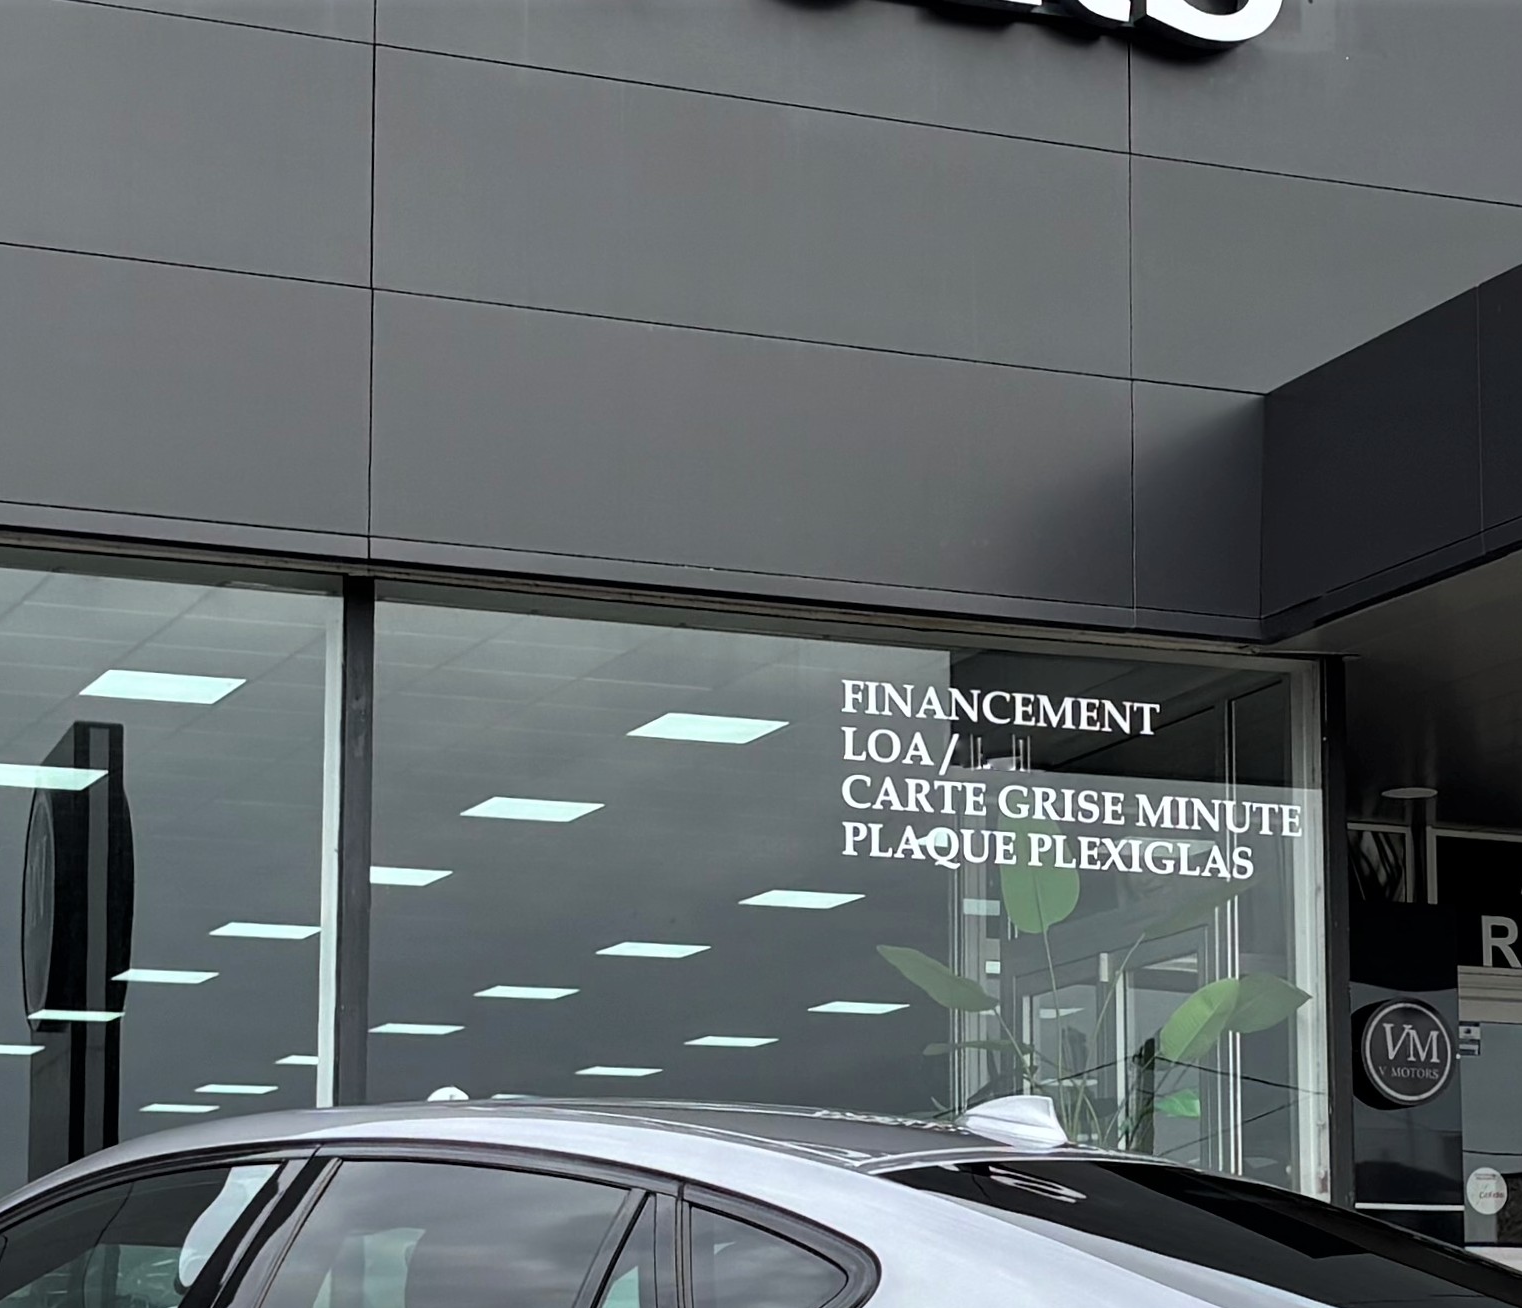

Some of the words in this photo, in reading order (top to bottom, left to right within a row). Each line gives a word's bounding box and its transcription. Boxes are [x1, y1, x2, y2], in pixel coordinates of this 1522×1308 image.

[840, 679, 1161, 737] FINANCEMENT
[841, 774, 987, 817] CARTE
[998, 785, 1125, 827] GRISE
[1135, 794, 1303, 838] MINUTE
[841, 821, 1017, 870] PLAQUE
[1027, 833, 1255, 880] PLEXIGLAS
[1382, 1022, 1441, 1064] VM
[1378, 1065, 1387, 1076] V
[1390, 1066, 1440, 1080] MOTORS
